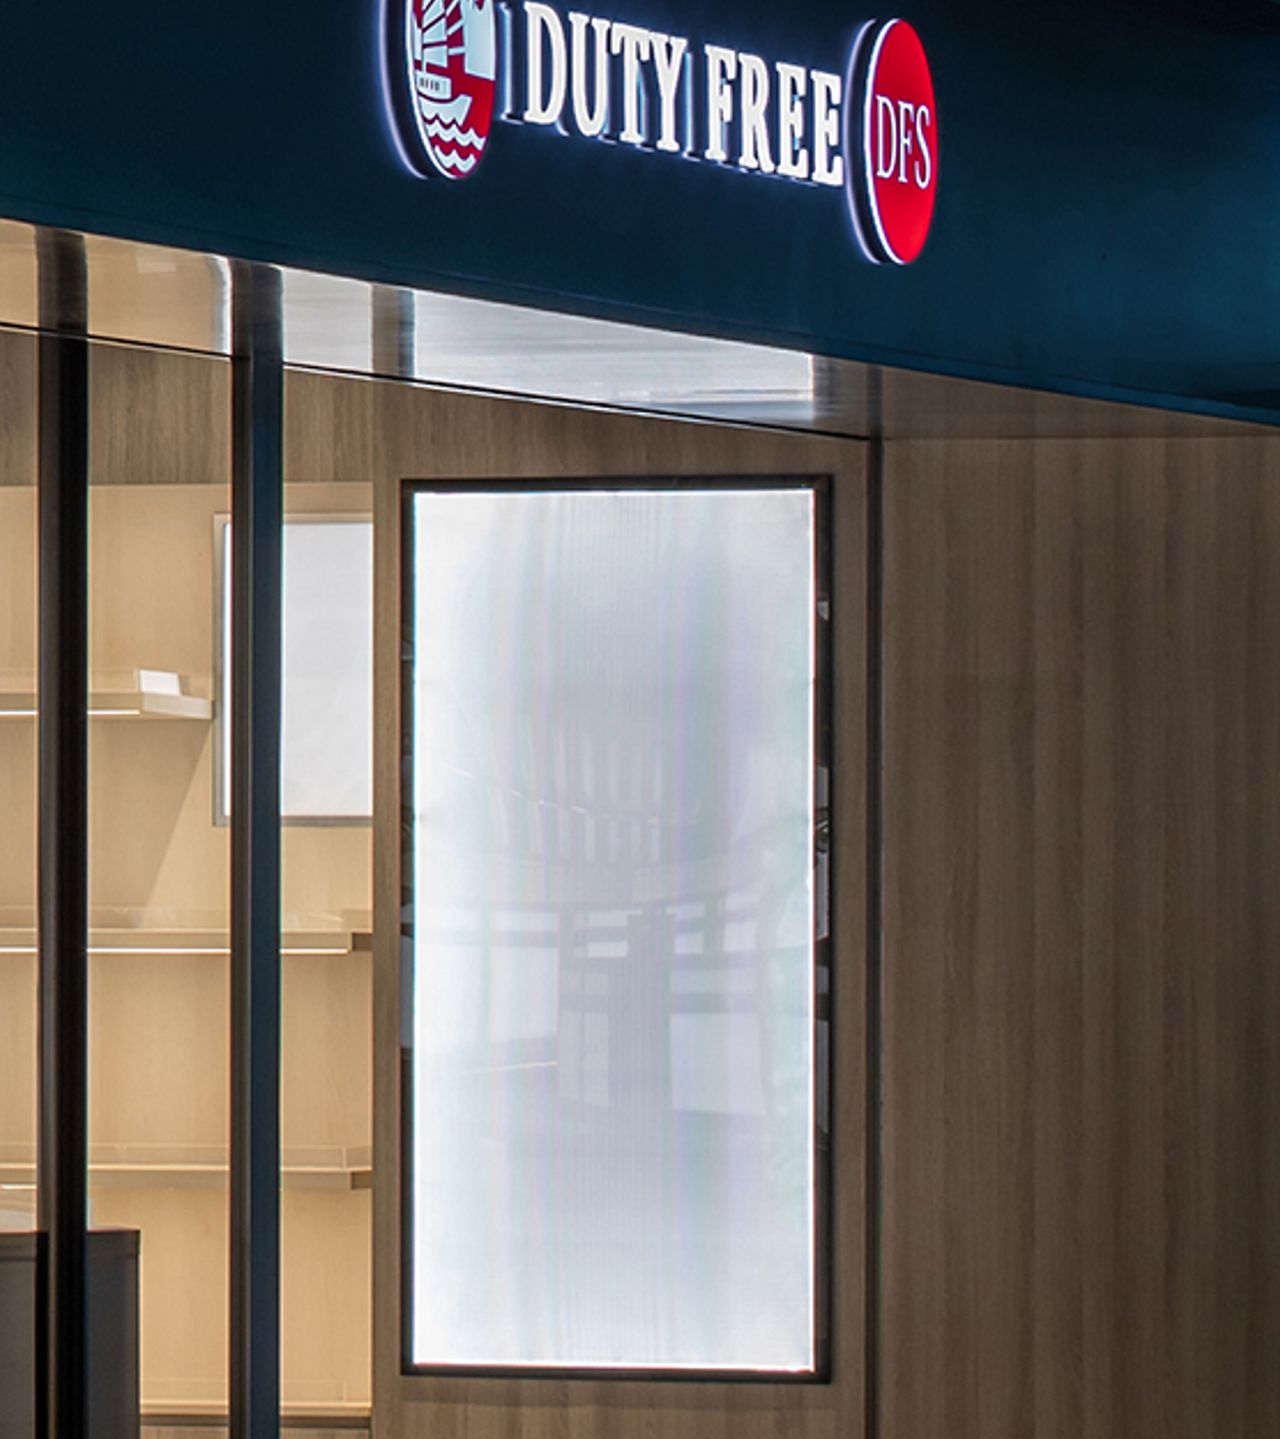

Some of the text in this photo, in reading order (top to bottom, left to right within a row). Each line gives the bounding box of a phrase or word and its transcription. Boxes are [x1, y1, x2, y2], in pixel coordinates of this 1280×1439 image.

[523, 1, 844, 187] DUTY FREE
[875, 94, 930, 189] DFS
